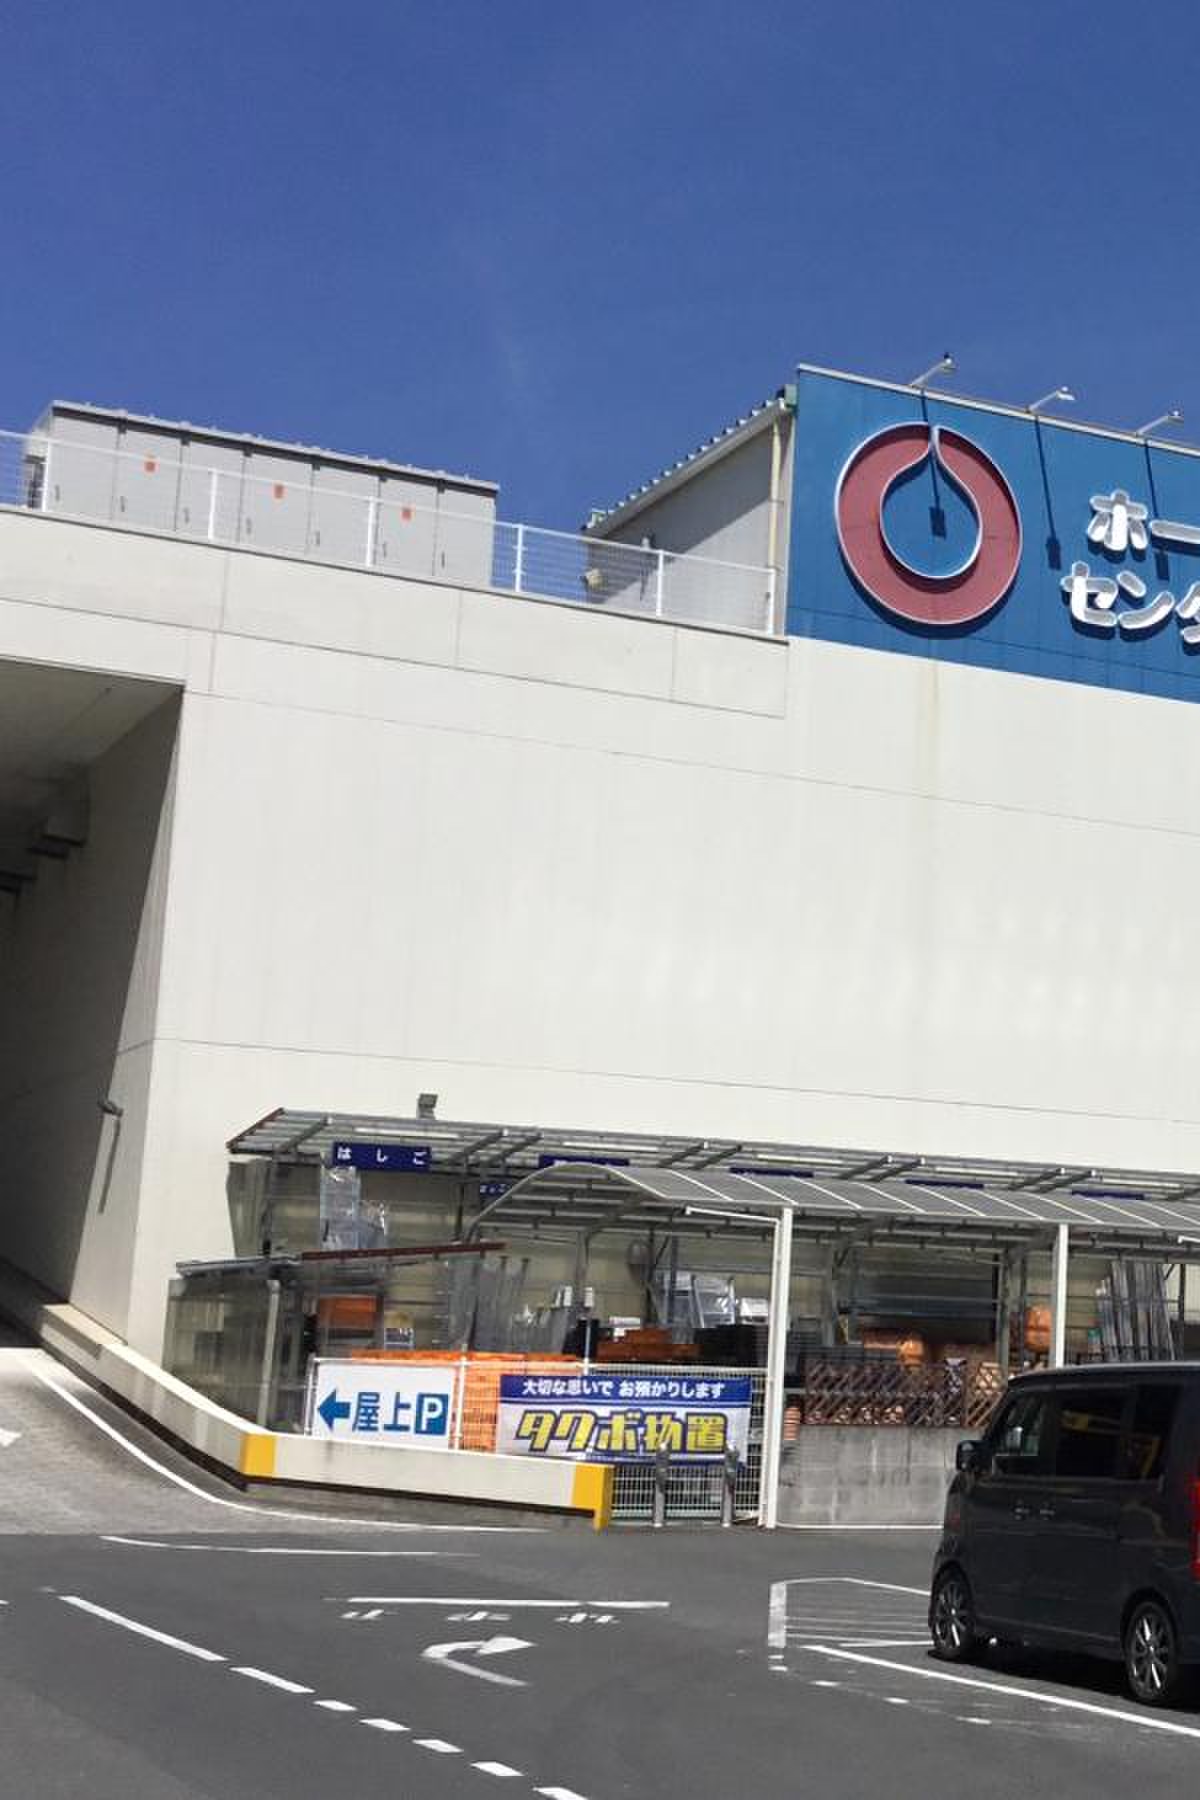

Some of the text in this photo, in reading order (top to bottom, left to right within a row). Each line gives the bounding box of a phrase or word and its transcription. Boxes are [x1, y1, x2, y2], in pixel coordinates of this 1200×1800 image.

[336, 1146, 428, 1165] はしご
[516, 1409, 728, 1453] タクボ物置
